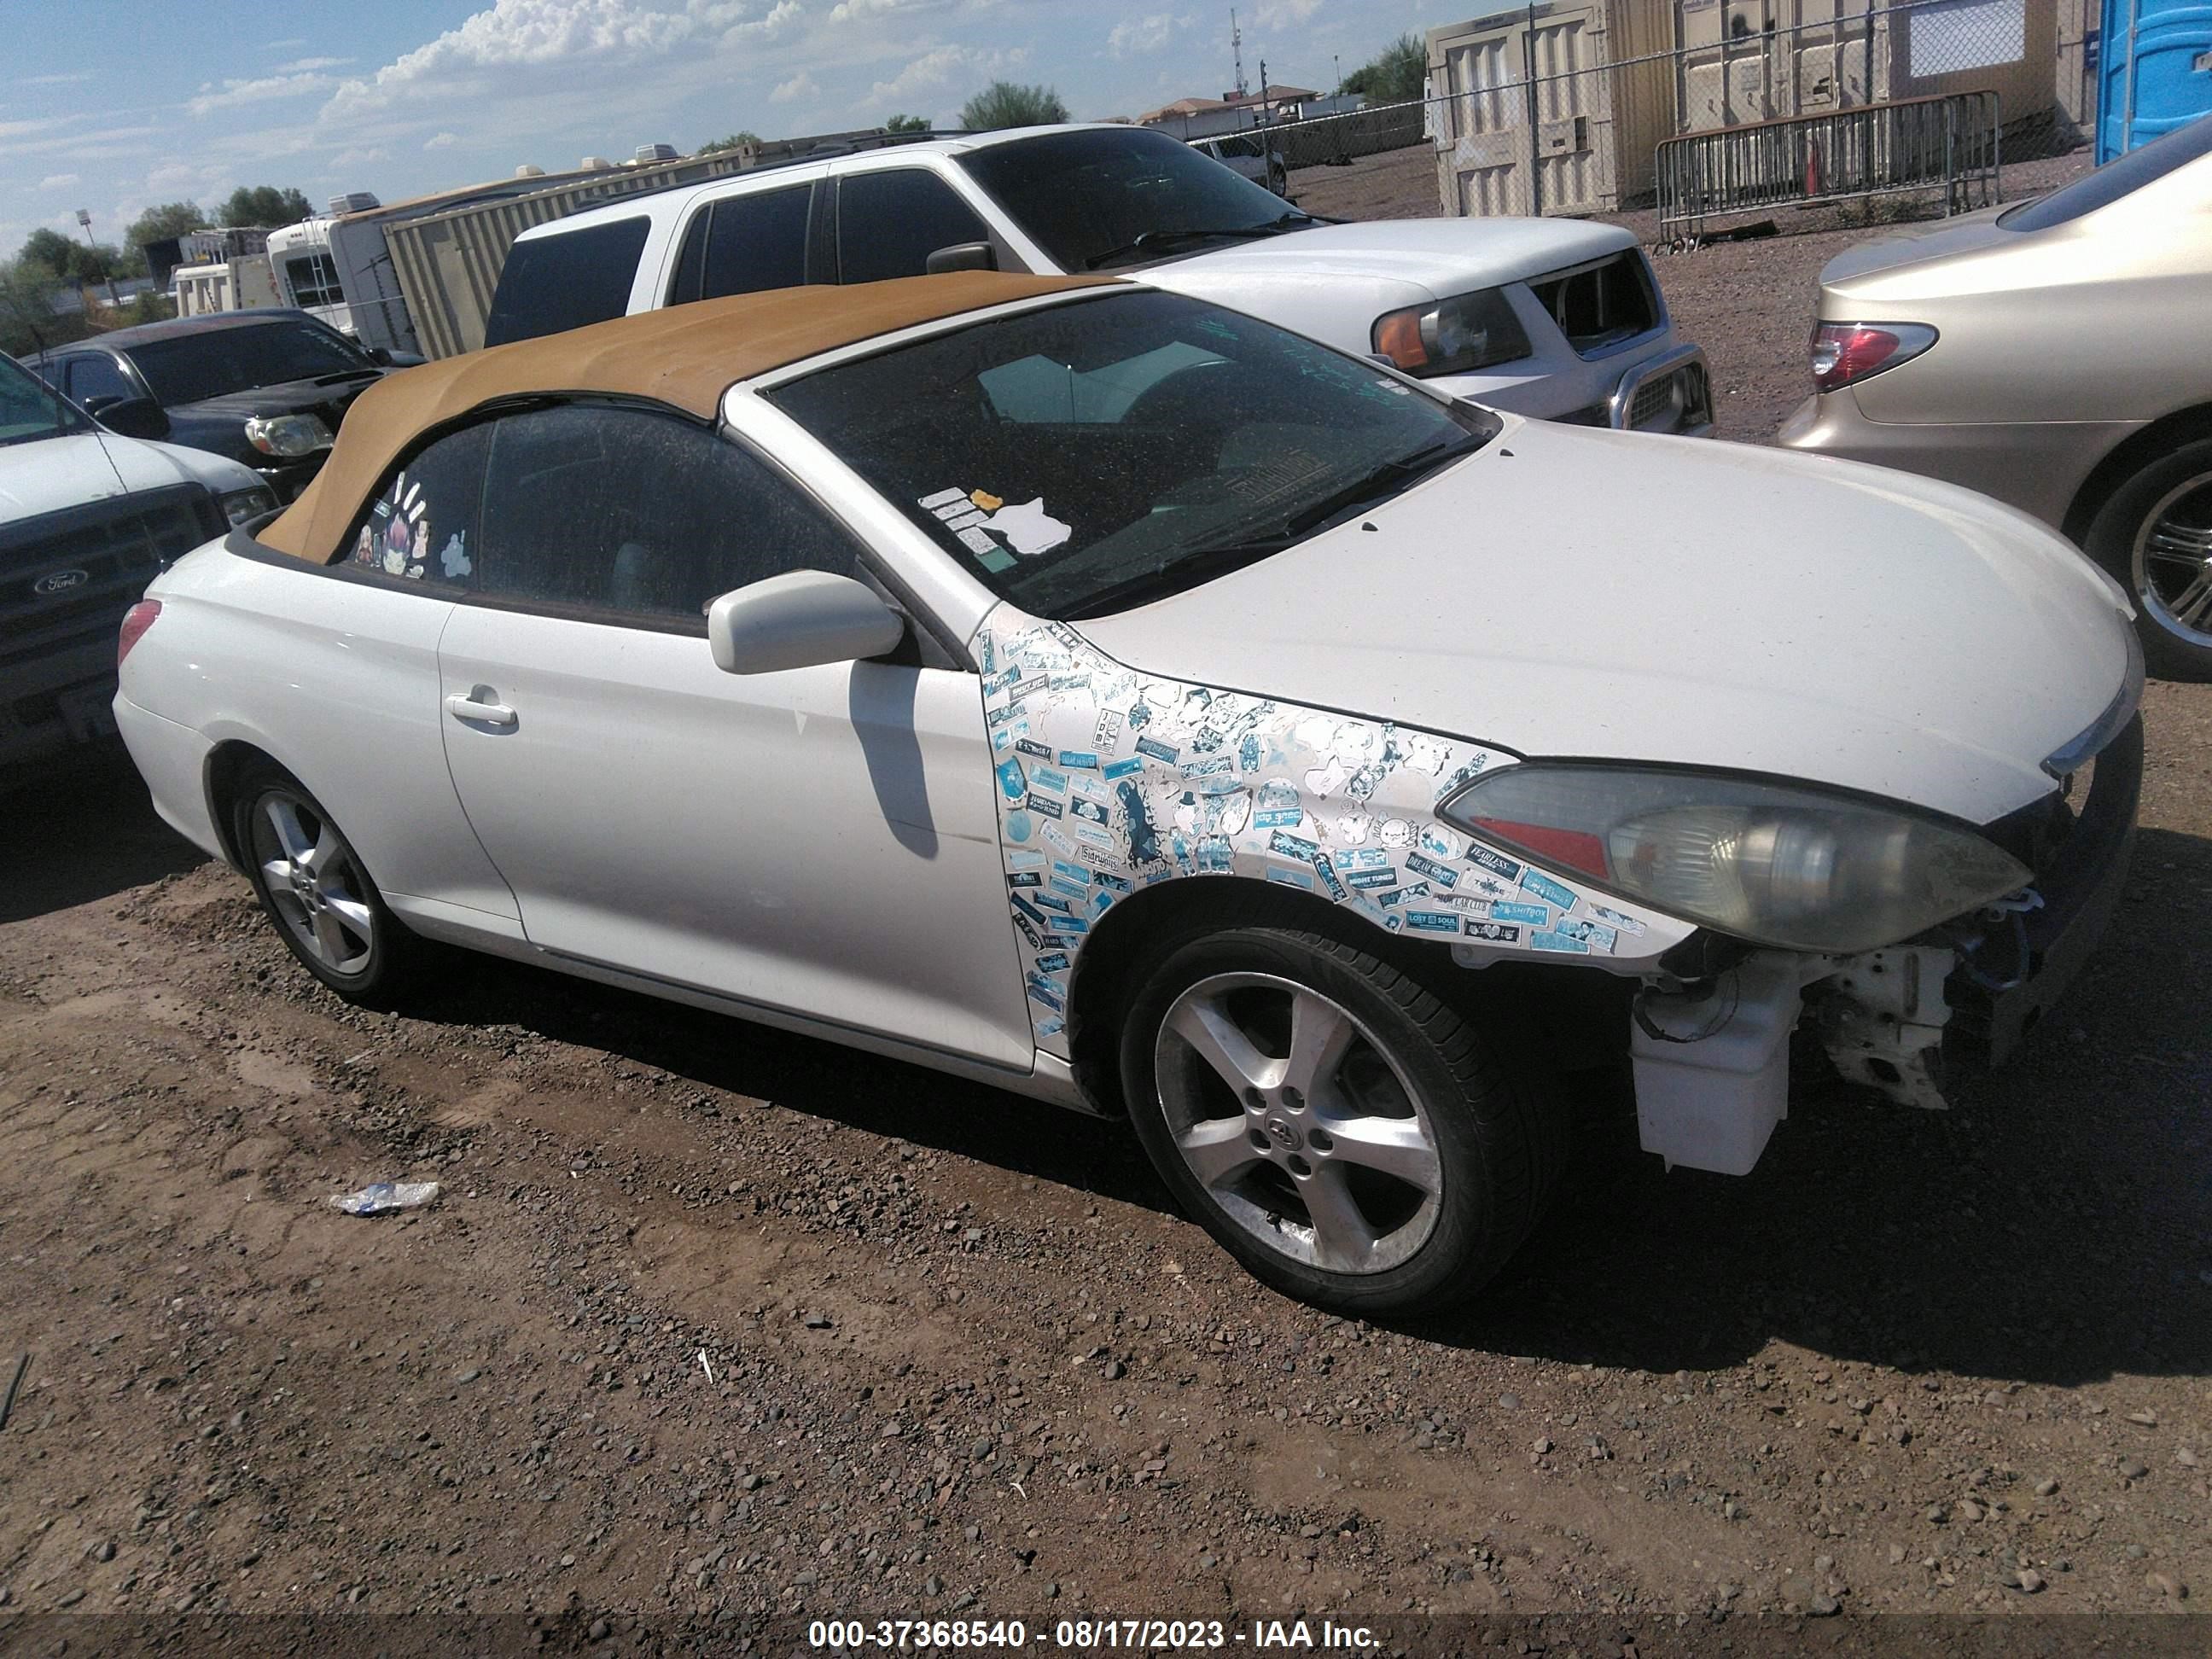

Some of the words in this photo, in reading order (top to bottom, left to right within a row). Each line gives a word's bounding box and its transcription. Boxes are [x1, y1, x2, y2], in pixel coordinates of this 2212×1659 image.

[48, 574, 76, 590] Ford
[1096, 713, 1108, 742] JDM
[1407, 856, 1431, 872] DREAM
[1470, 847, 1510, 869] FEARLESS
[1372, 873, 1394, 882] TUNED
[1455, 897, 1470, 907] CAR
[1470, 899, 1487, 911] CLUB
[1513, 906, 1546, 917] SHITBOX
